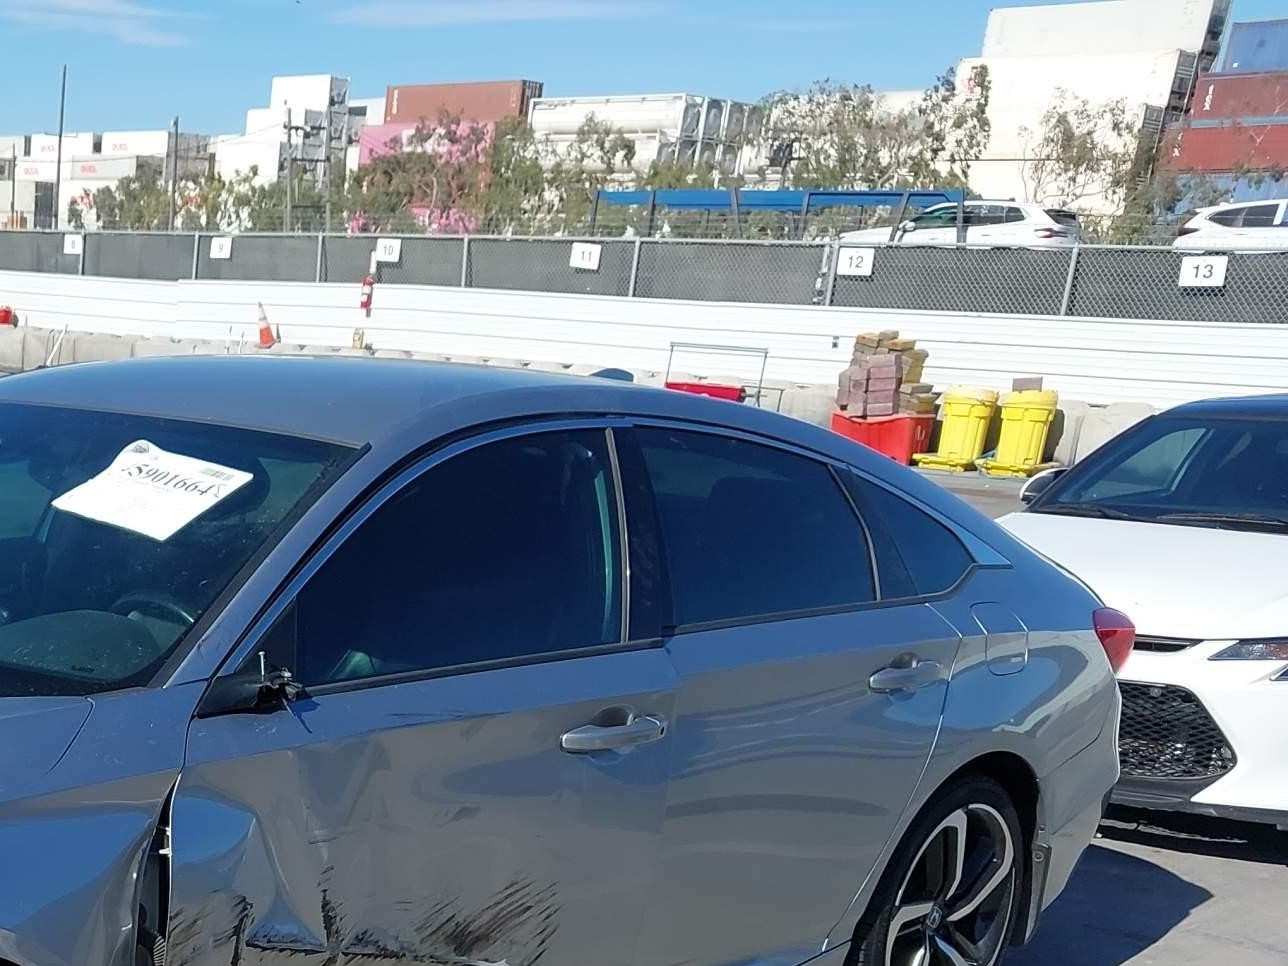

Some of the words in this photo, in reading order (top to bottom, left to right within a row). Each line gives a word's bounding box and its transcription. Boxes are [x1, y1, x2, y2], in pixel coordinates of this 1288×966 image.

[383, 244, 394, 256] 10
[580, 250, 593, 262] 11
[847, 255, 864, 269] 12
[1192, 264, 1215, 279] 13
